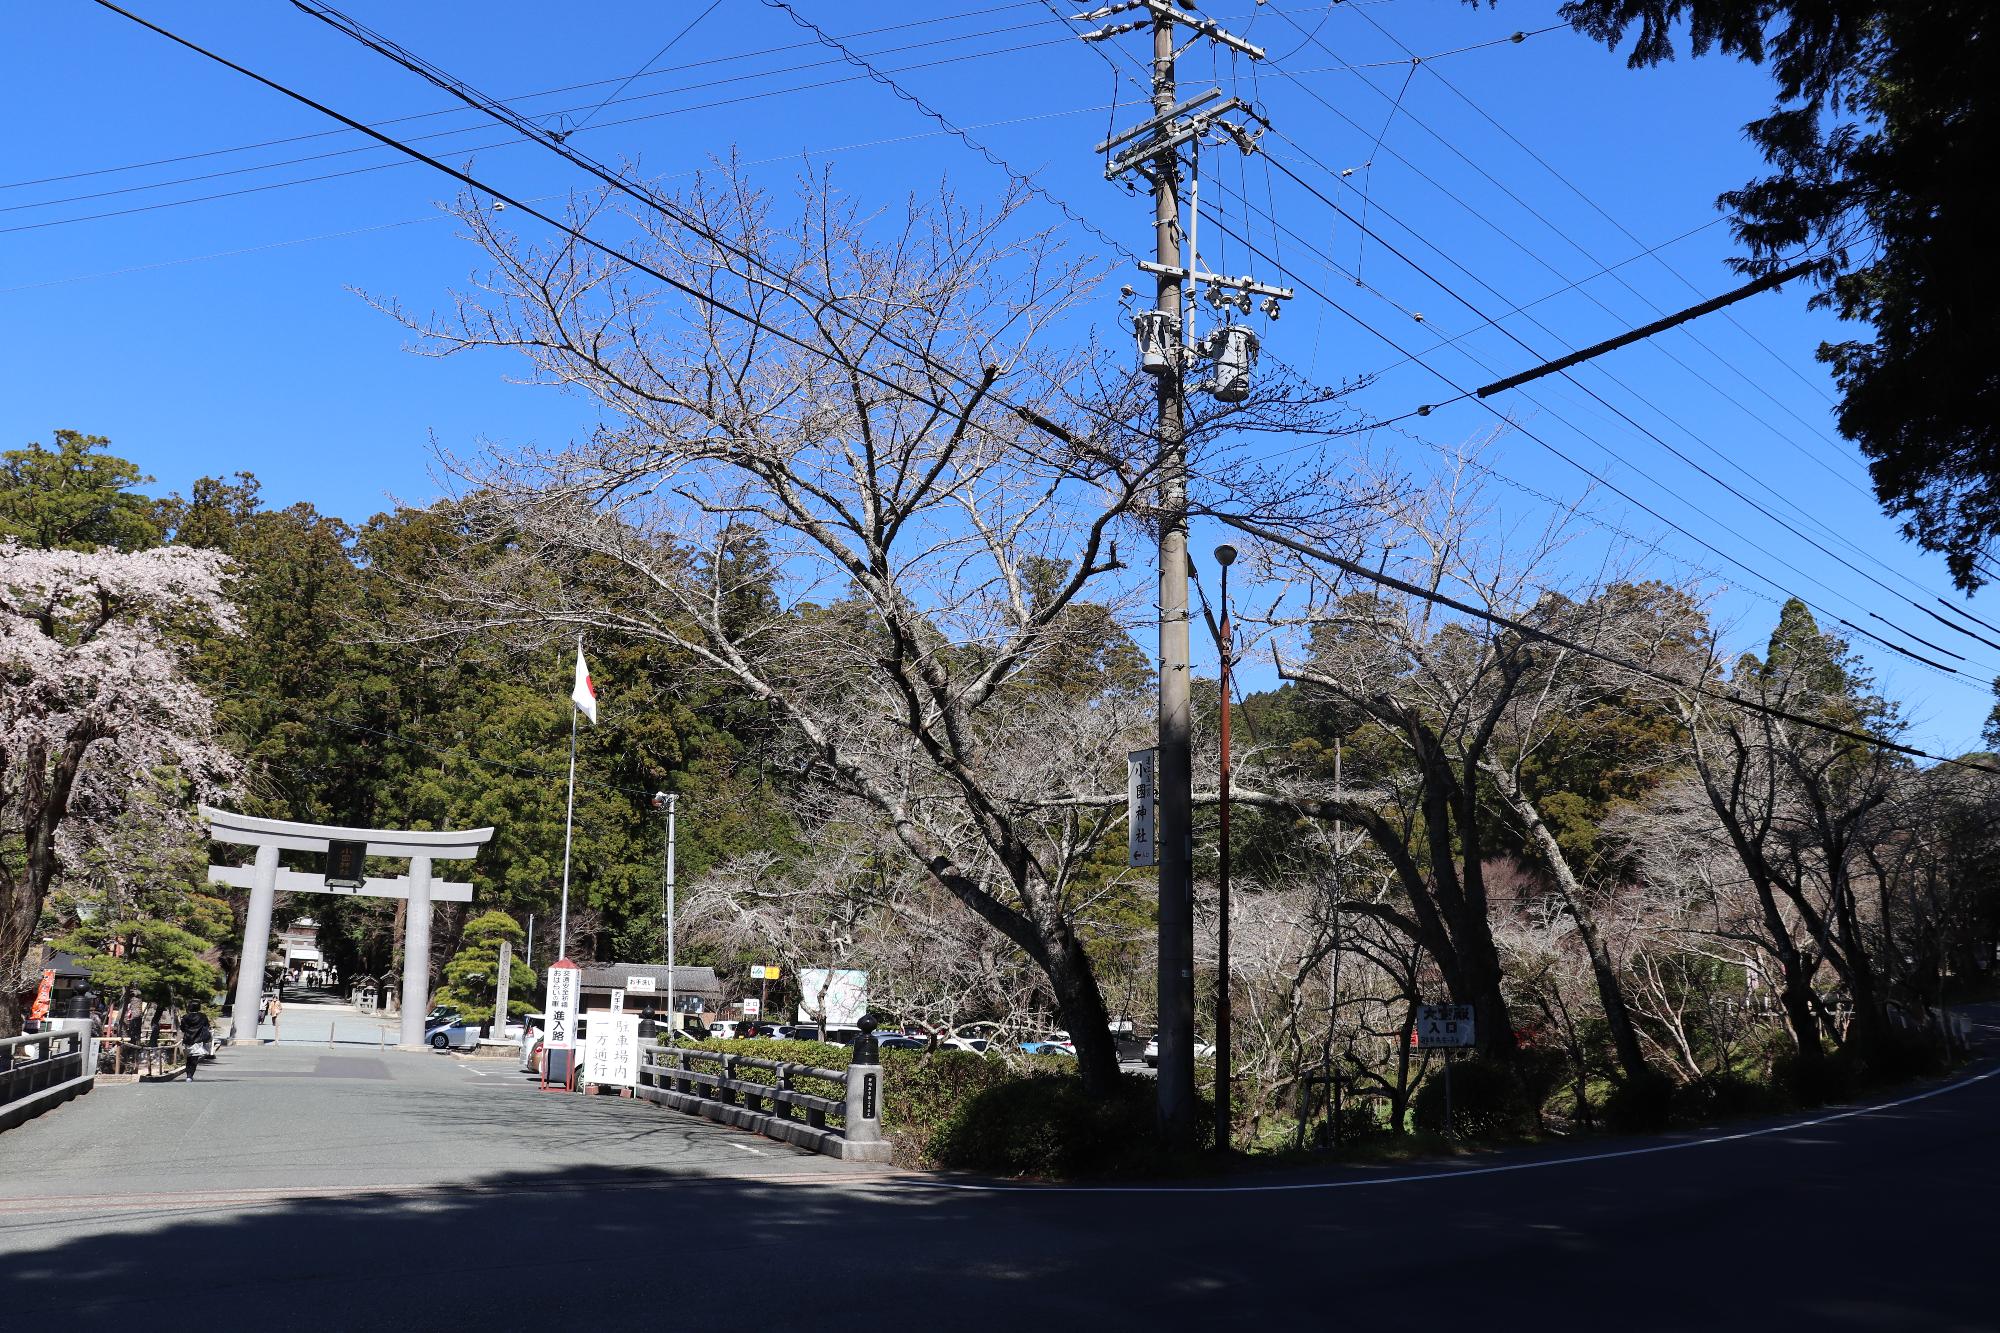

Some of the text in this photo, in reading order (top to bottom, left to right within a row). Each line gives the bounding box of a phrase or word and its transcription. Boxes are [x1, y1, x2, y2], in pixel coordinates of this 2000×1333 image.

[1135, 762, 1147, 843] 小國神社
[629, 978, 654, 986] お手洗い
[551, 1010, 565, 1041] 進入路
[1428, 1021, 1458, 1034] 入口
[592, 1021, 609, 1077] 一方通行
[613, 1020, 630, 1080] 駐車場内
